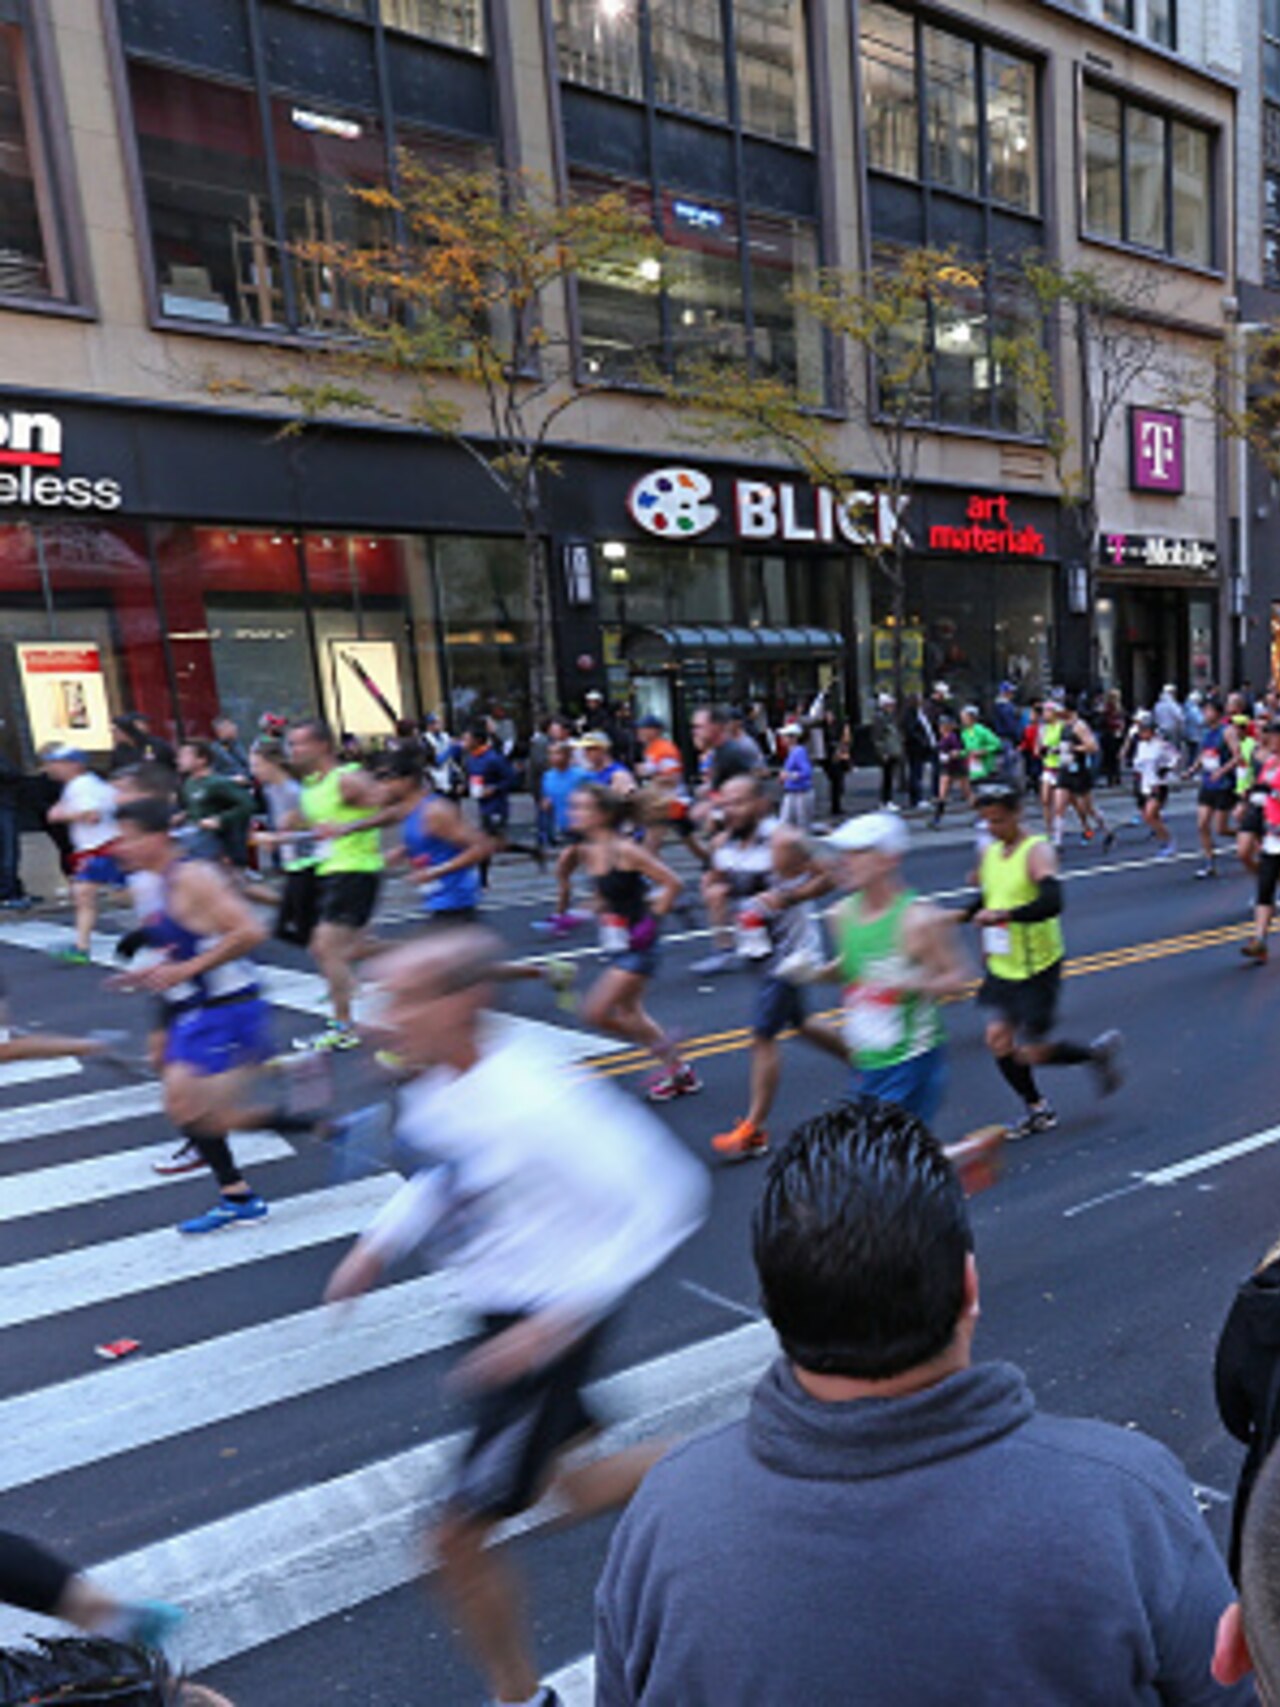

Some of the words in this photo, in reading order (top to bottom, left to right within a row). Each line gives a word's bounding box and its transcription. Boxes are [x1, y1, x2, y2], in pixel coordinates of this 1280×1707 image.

[1141, 421, 1174, 480] T
[734, 480, 915, 547] BLICK
[966, 494, 1009, 522] art
[929, 521, 1045, 557] materials
